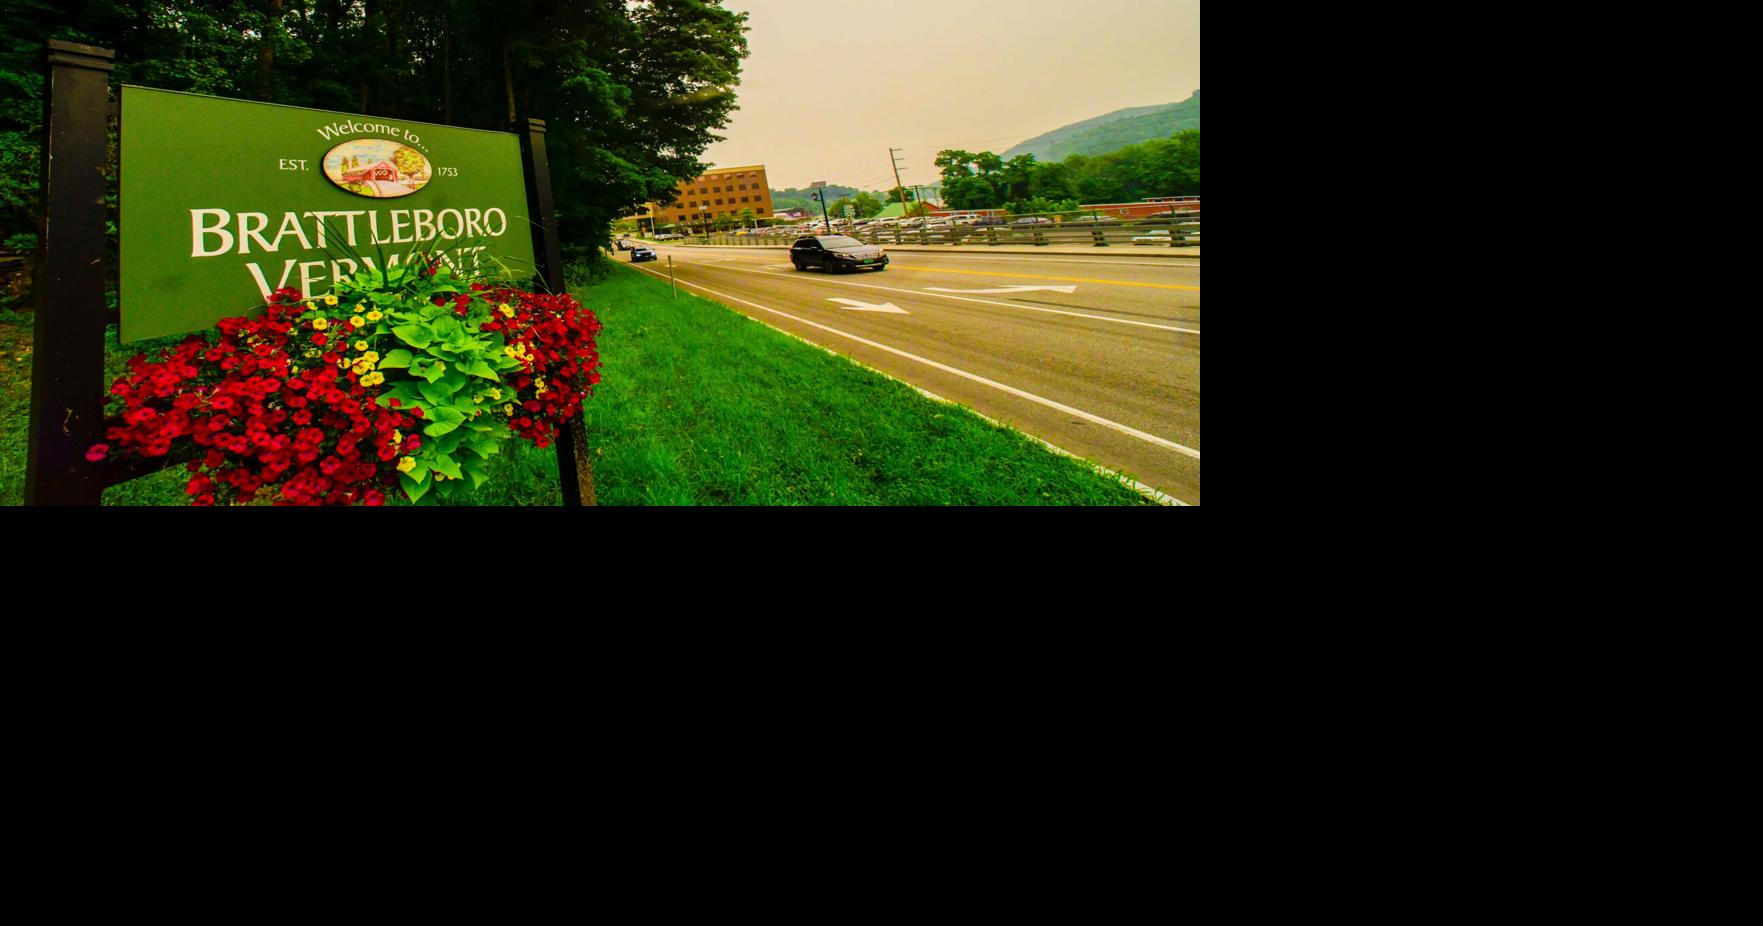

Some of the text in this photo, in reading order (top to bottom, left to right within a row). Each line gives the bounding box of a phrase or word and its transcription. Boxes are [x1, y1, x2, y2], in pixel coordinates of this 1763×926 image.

[317, 119, 400, 140] Welcome
[279, 158, 309, 171] EST.
[437, 167, 458, 177] 1753
[189, 206, 507, 257] BRATTLEBORO
